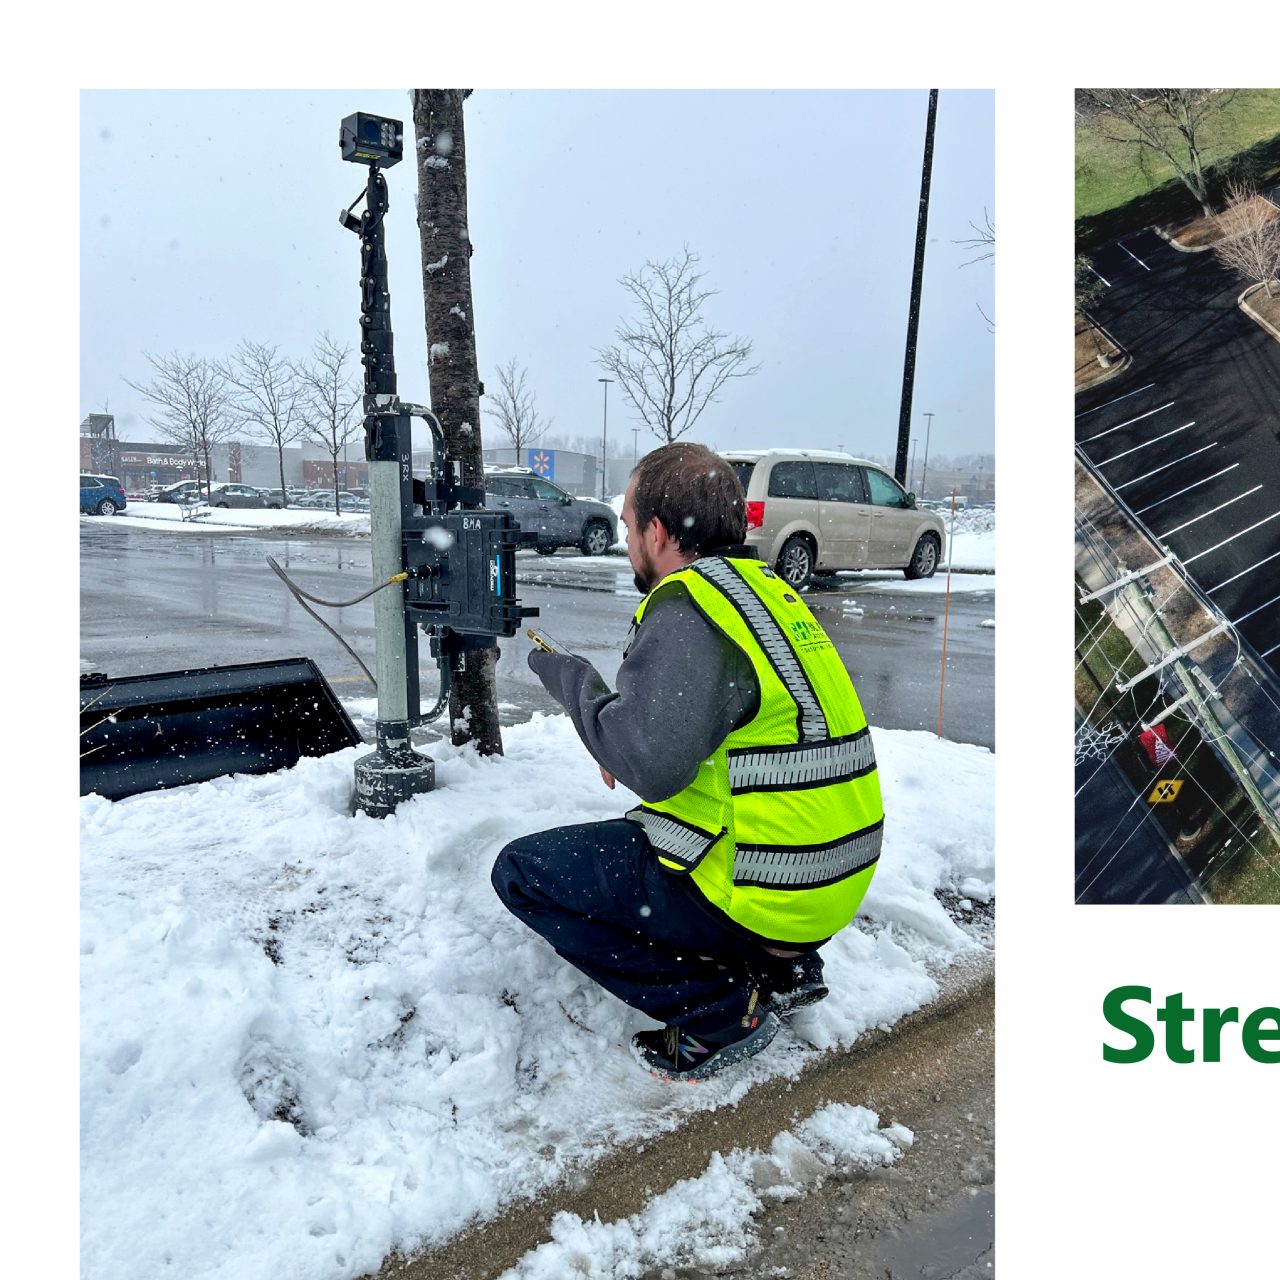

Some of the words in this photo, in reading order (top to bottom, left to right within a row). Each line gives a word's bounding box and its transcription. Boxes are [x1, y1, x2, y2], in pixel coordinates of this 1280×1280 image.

[146, 456, 163, 465] Bath
[163, 457, 169, 465] &
[169, 457, 187, 467] Body
